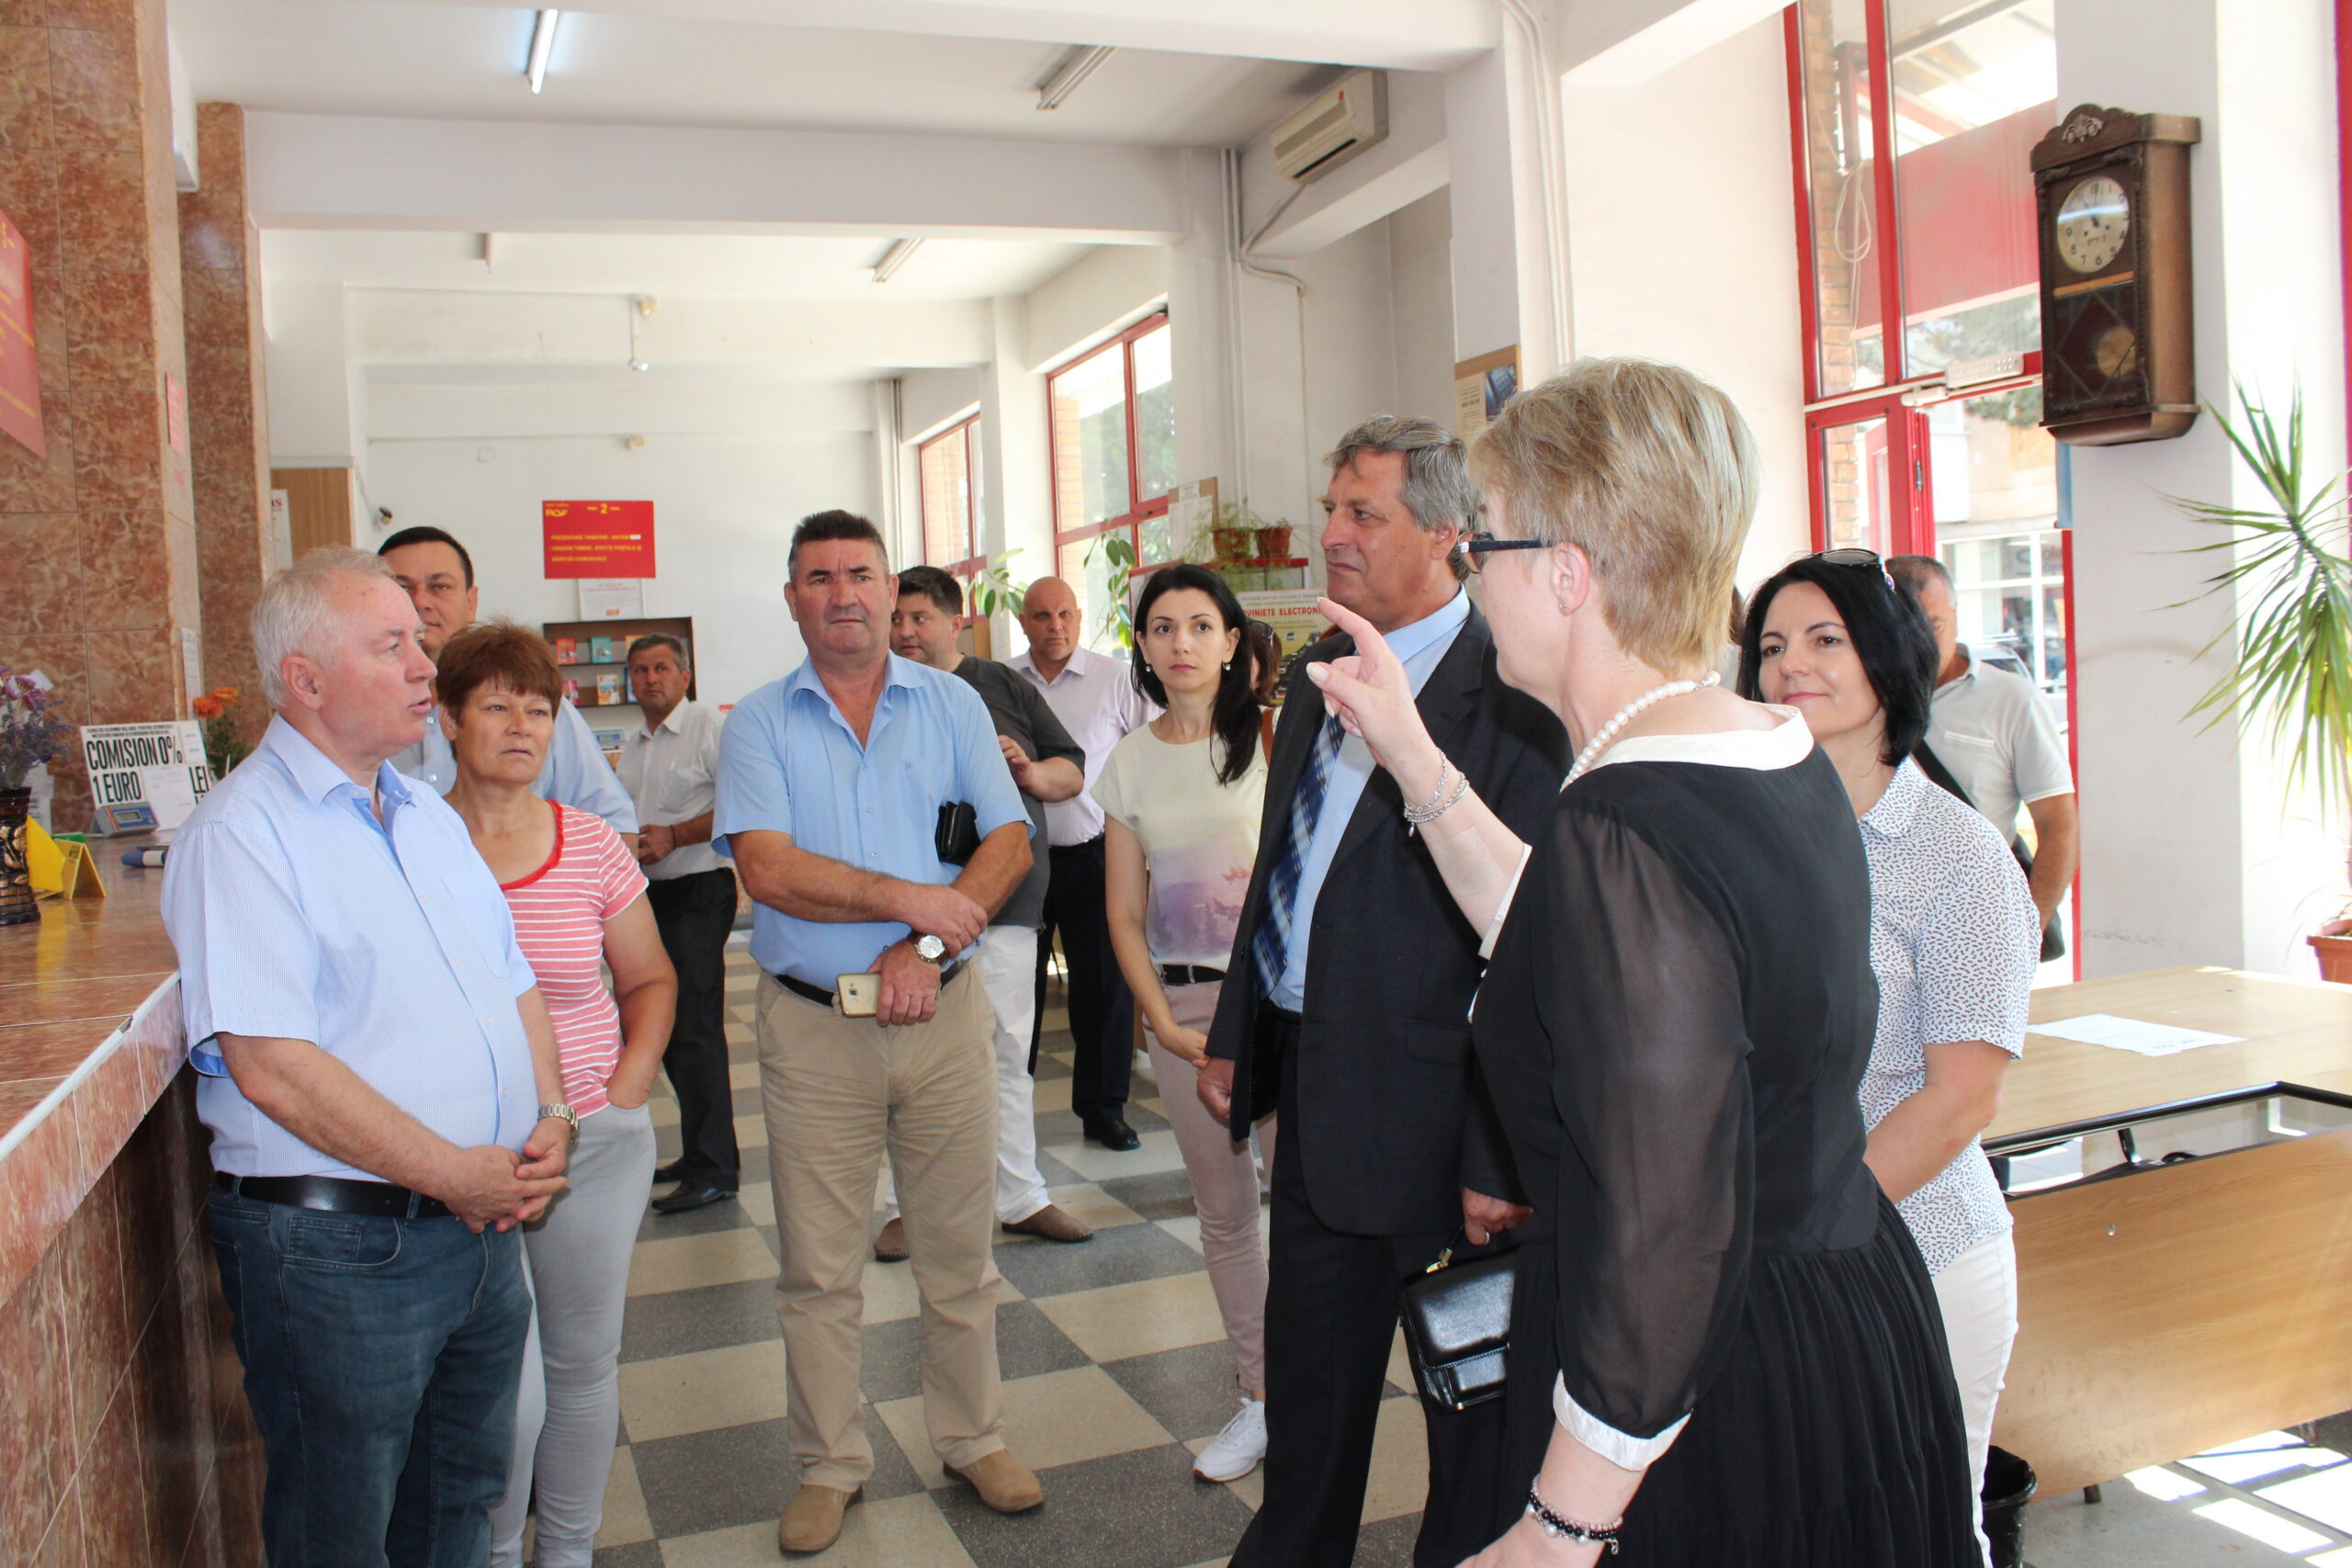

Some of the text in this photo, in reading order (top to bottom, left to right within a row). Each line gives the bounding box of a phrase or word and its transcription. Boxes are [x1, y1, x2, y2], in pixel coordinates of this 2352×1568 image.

[2066, 227, 2073, 237] 9
[2081, 254, 2086, 265] 7
[2096, 255, 2103, 265] 6
[600, 502, 608, 514] 2
[1243, 606, 1324, 618] VINIETE ELECTRONI
[85, 735, 183, 771] COMISION 0%
[93, 765, 210, 804] 1 EURO LEI
